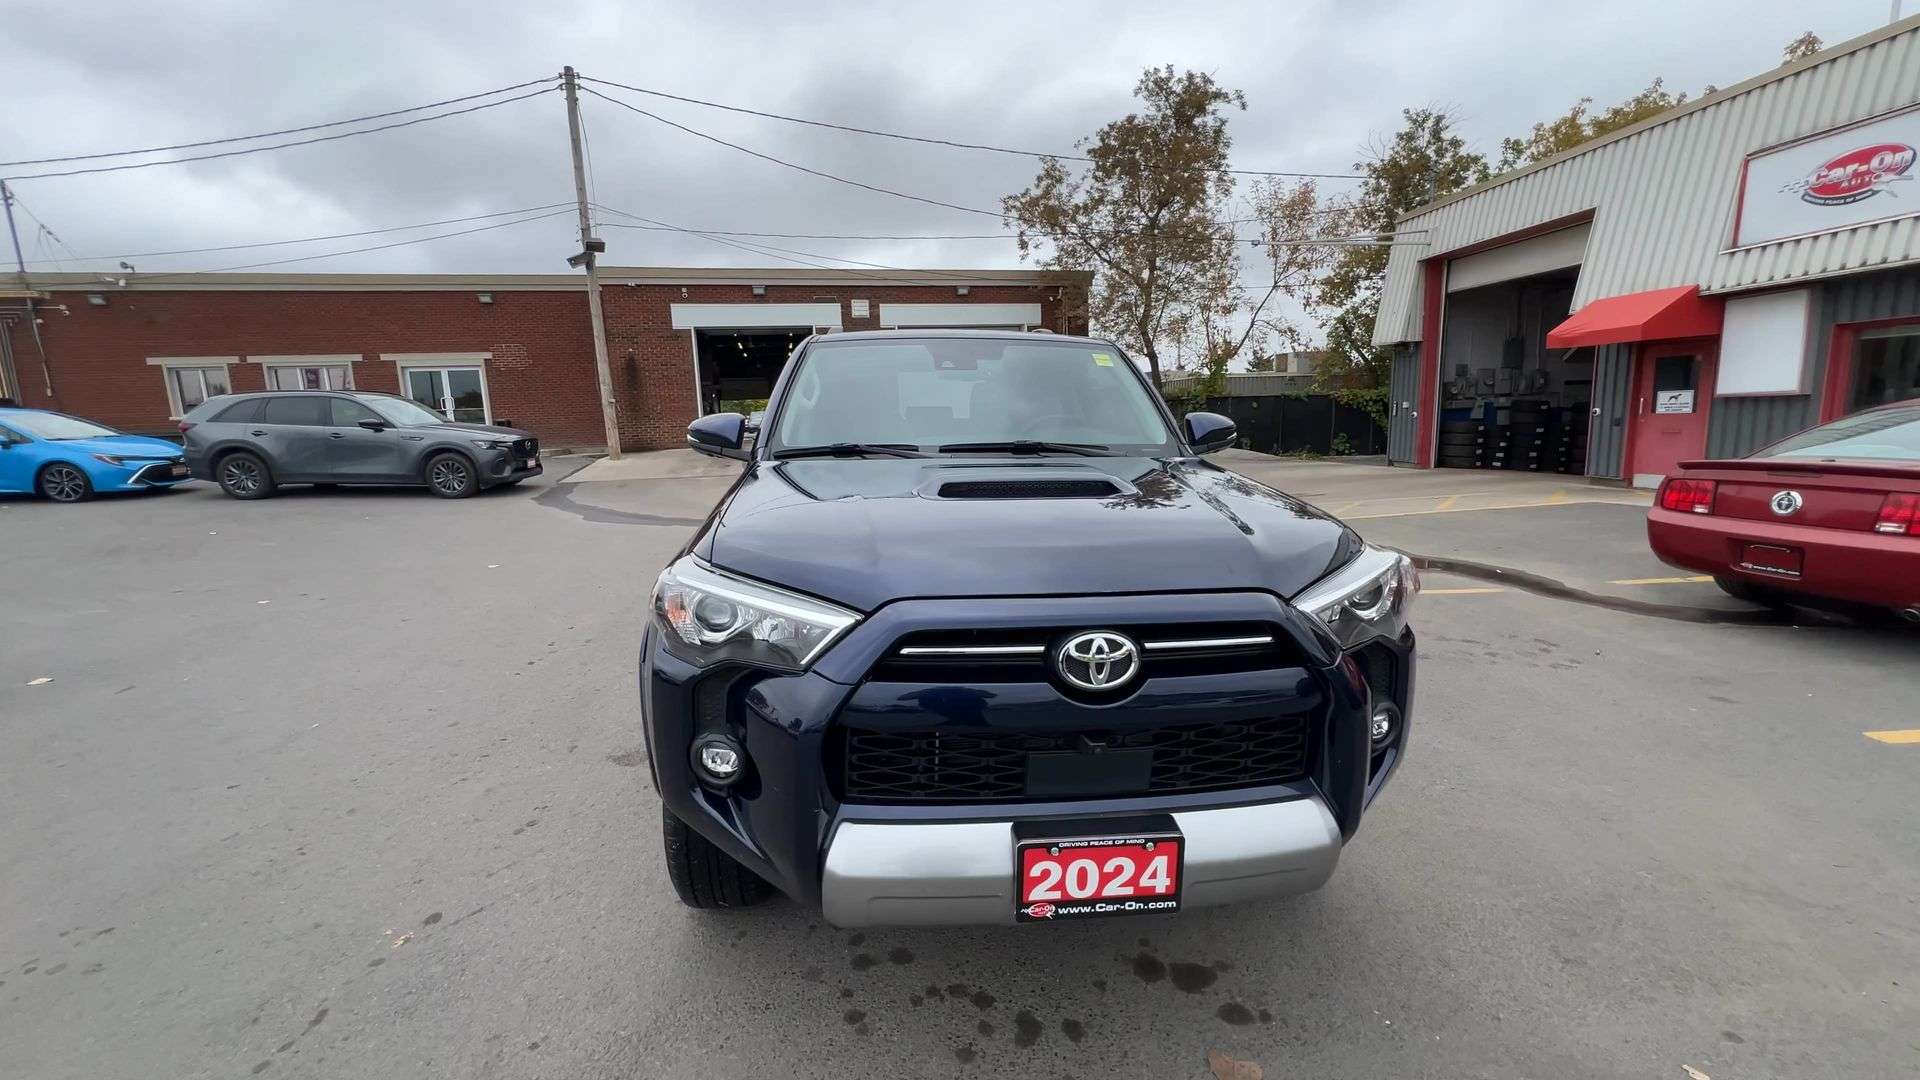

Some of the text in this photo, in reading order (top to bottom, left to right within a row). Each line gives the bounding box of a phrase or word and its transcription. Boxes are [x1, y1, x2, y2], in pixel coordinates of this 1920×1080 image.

[1808, 150, 1914, 188] Car-On
[1028, 855, 1171, 901] 2024
[1058, 901, 1177, 915] www.Car-On.com
